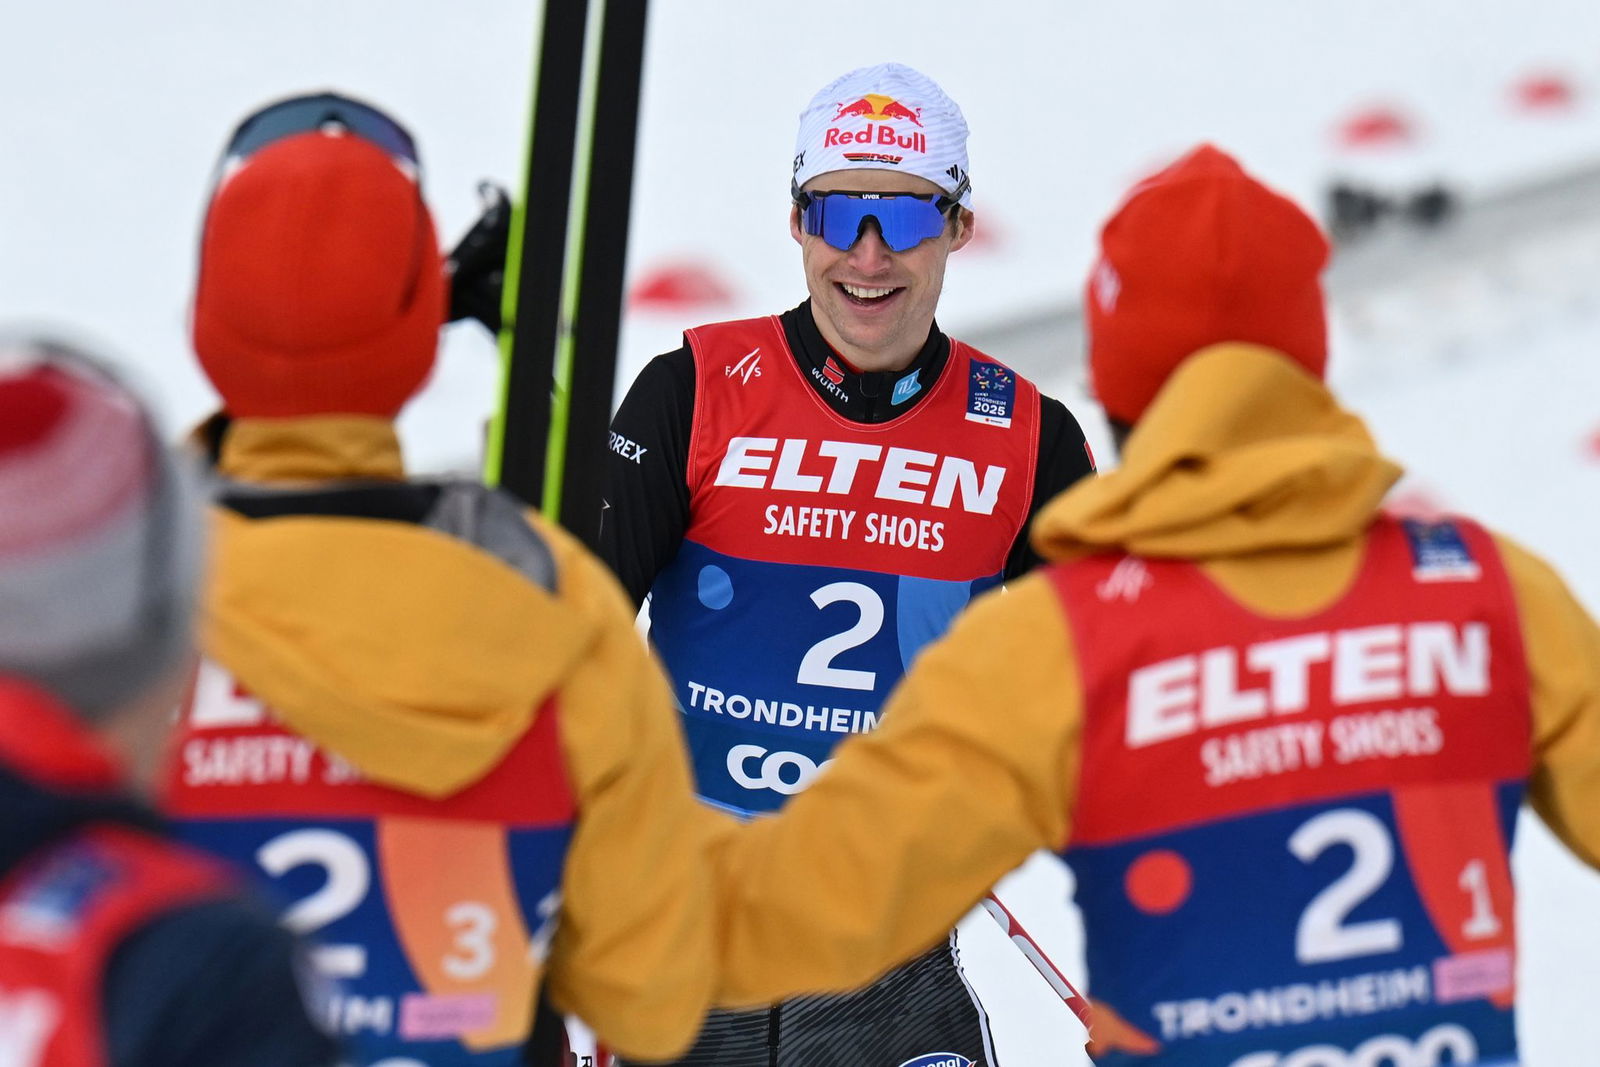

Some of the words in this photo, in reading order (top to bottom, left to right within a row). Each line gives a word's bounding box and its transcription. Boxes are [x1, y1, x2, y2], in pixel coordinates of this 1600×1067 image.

[824, 123, 873, 149] Red
[877, 125, 926, 154] Bull
[608, 430, 648, 464] RREX
[973, 401, 1006, 416] 2025
[713, 436, 1006, 515] ELTEN
[763, 504, 857, 540] SAFETY
[865, 511, 945, 552] SHOES
[796, 581, 885, 691] 2
[1124, 621, 1491, 748] ELTEN
[183, 735, 315, 785] SAFETY
[1201, 722, 1323, 786] SAFETY
[1330, 708, 1443, 763] SHOES
[1288, 808, 1403, 964] 2
[1458, 860, 1501, 940] 1
[441, 901, 497, 980] 3
[1153, 966, 1430, 1040] TRONDHEIM
